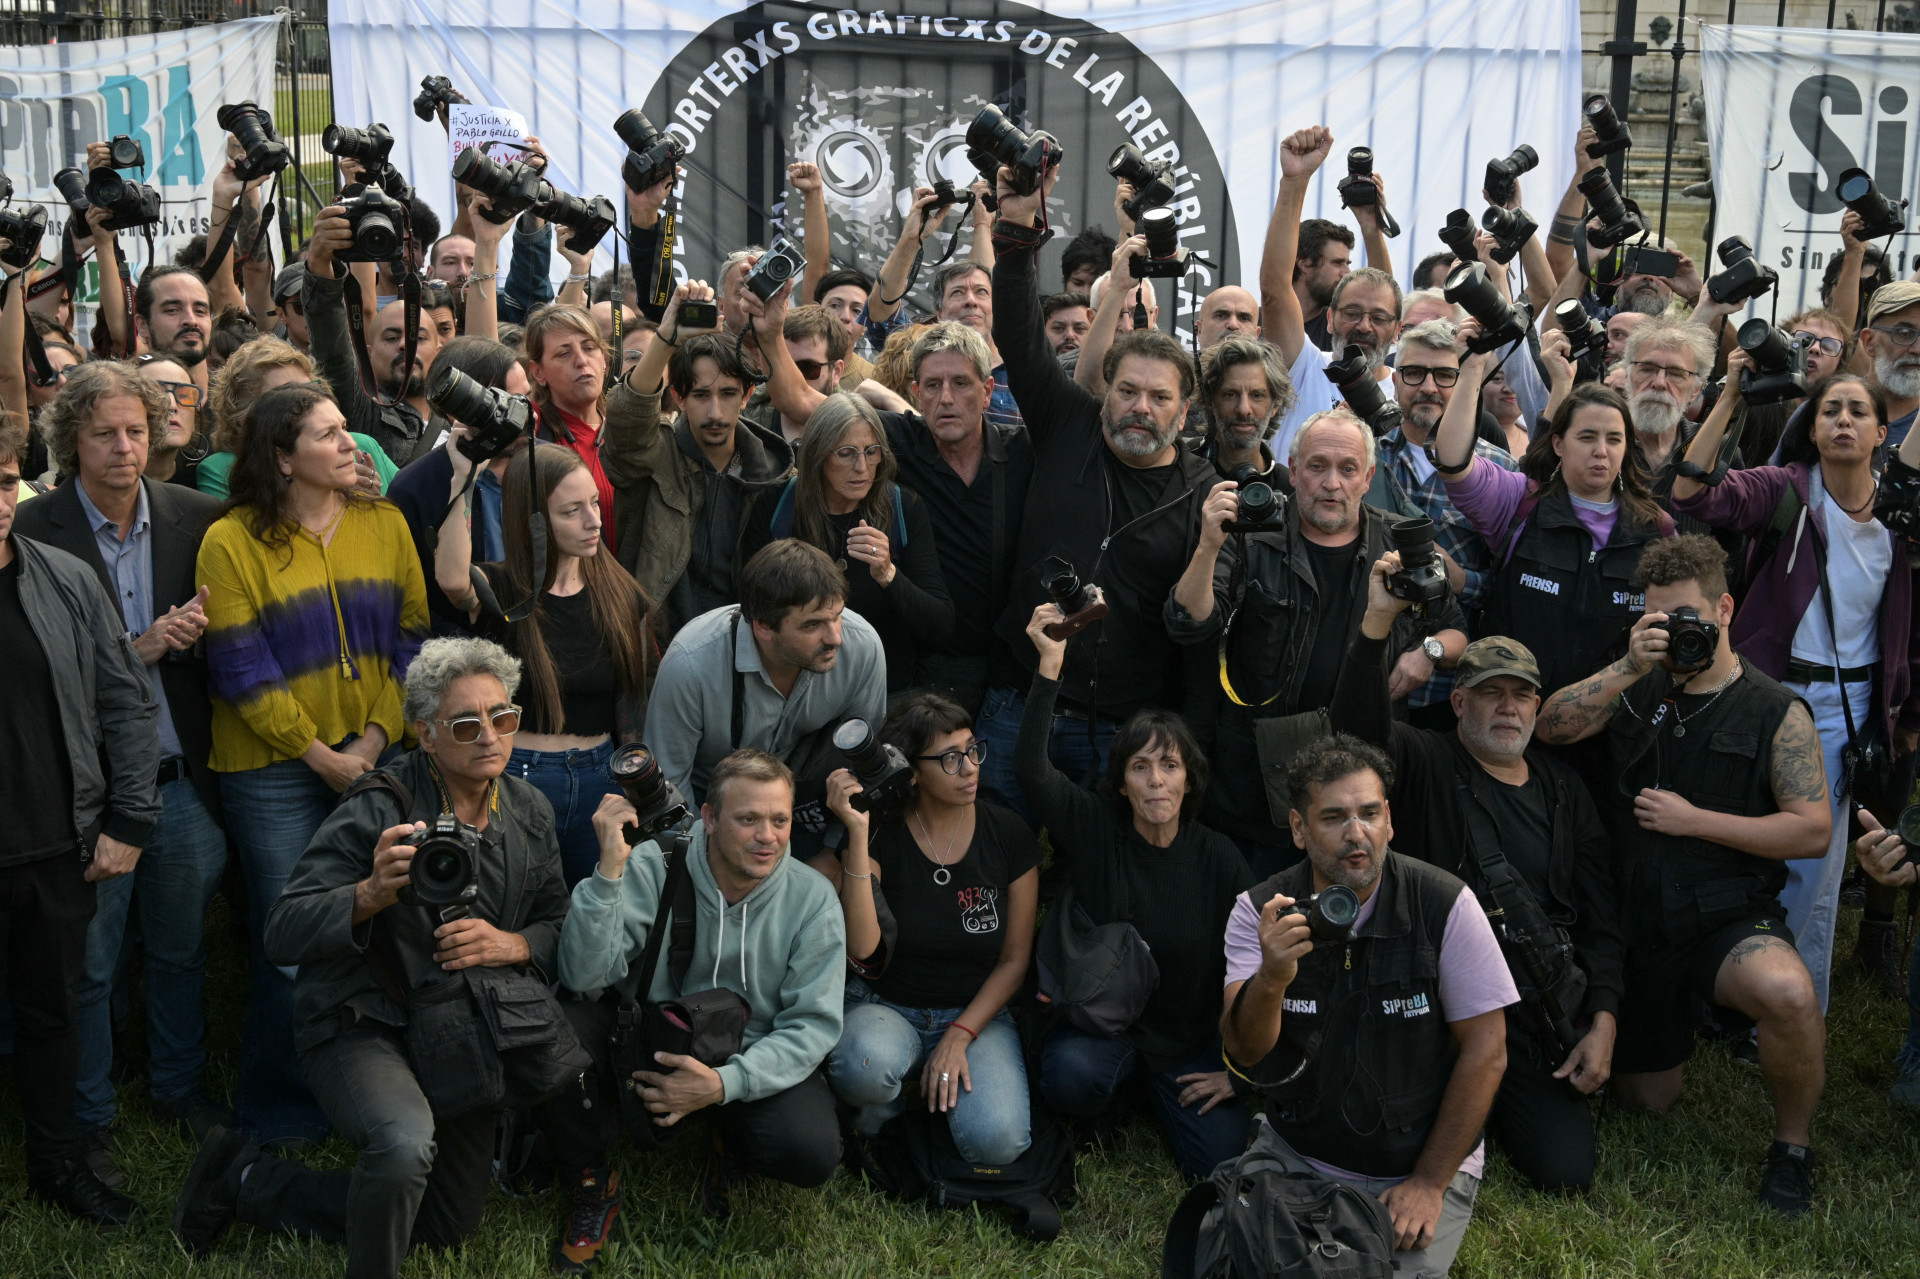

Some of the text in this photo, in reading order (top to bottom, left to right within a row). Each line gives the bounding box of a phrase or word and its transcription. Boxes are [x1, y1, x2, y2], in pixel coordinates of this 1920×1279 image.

[1019, 28, 1079, 70] DE
[1072, 52, 1125, 107] LA
[455, 127, 520, 139] PABLO GRILLO
[1788, 74, 1920, 216] Si
[31, 278, 57, 294] Canon
[351, 303, 363, 330] EOS
[408, 303, 417, 342] Canon
[1519, 572, 1560, 596] PRENSA
[1612, 591, 1645, 605] SiPreB
[957, 886, 981, 910] 89.3
[1282, 998, 1317, 1014] RENSA
[1382, 992, 1429, 1015] SiPreBA
